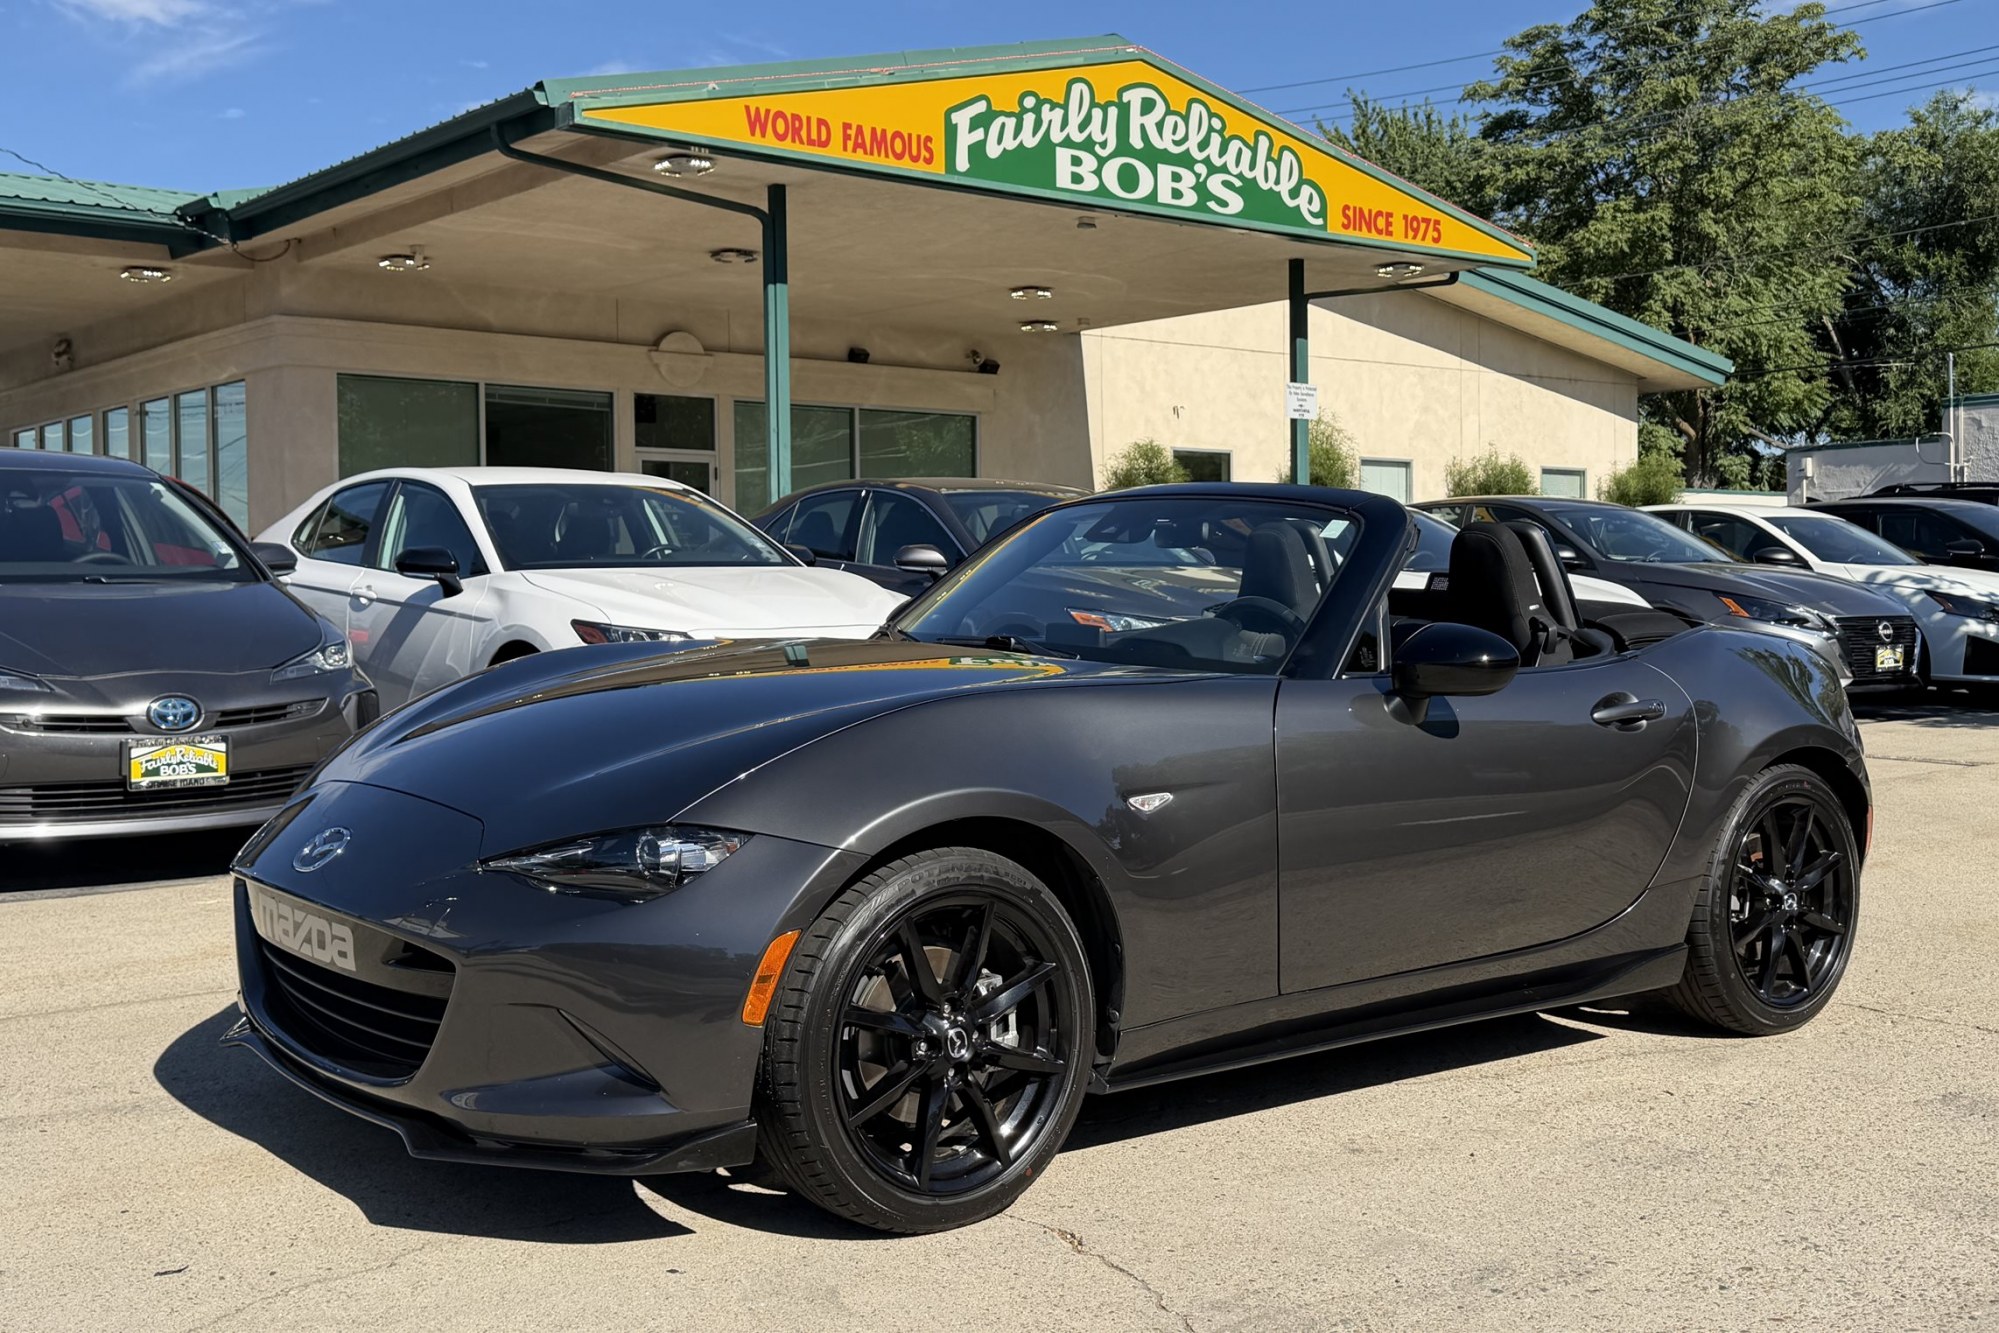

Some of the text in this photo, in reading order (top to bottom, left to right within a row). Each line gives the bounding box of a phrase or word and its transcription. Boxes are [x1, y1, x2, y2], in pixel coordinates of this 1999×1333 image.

[744, 104, 935, 166] WORLD FAMOUS
[950, 82, 1324, 226] Fairly Reliable
[1055, 146, 1245, 216] BOB'S
[1341, 203, 1442, 244] SINCE 1975
[140, 747, 218, 773] Fairly Reliable
[160, 763, 197, 776] BOB'S
